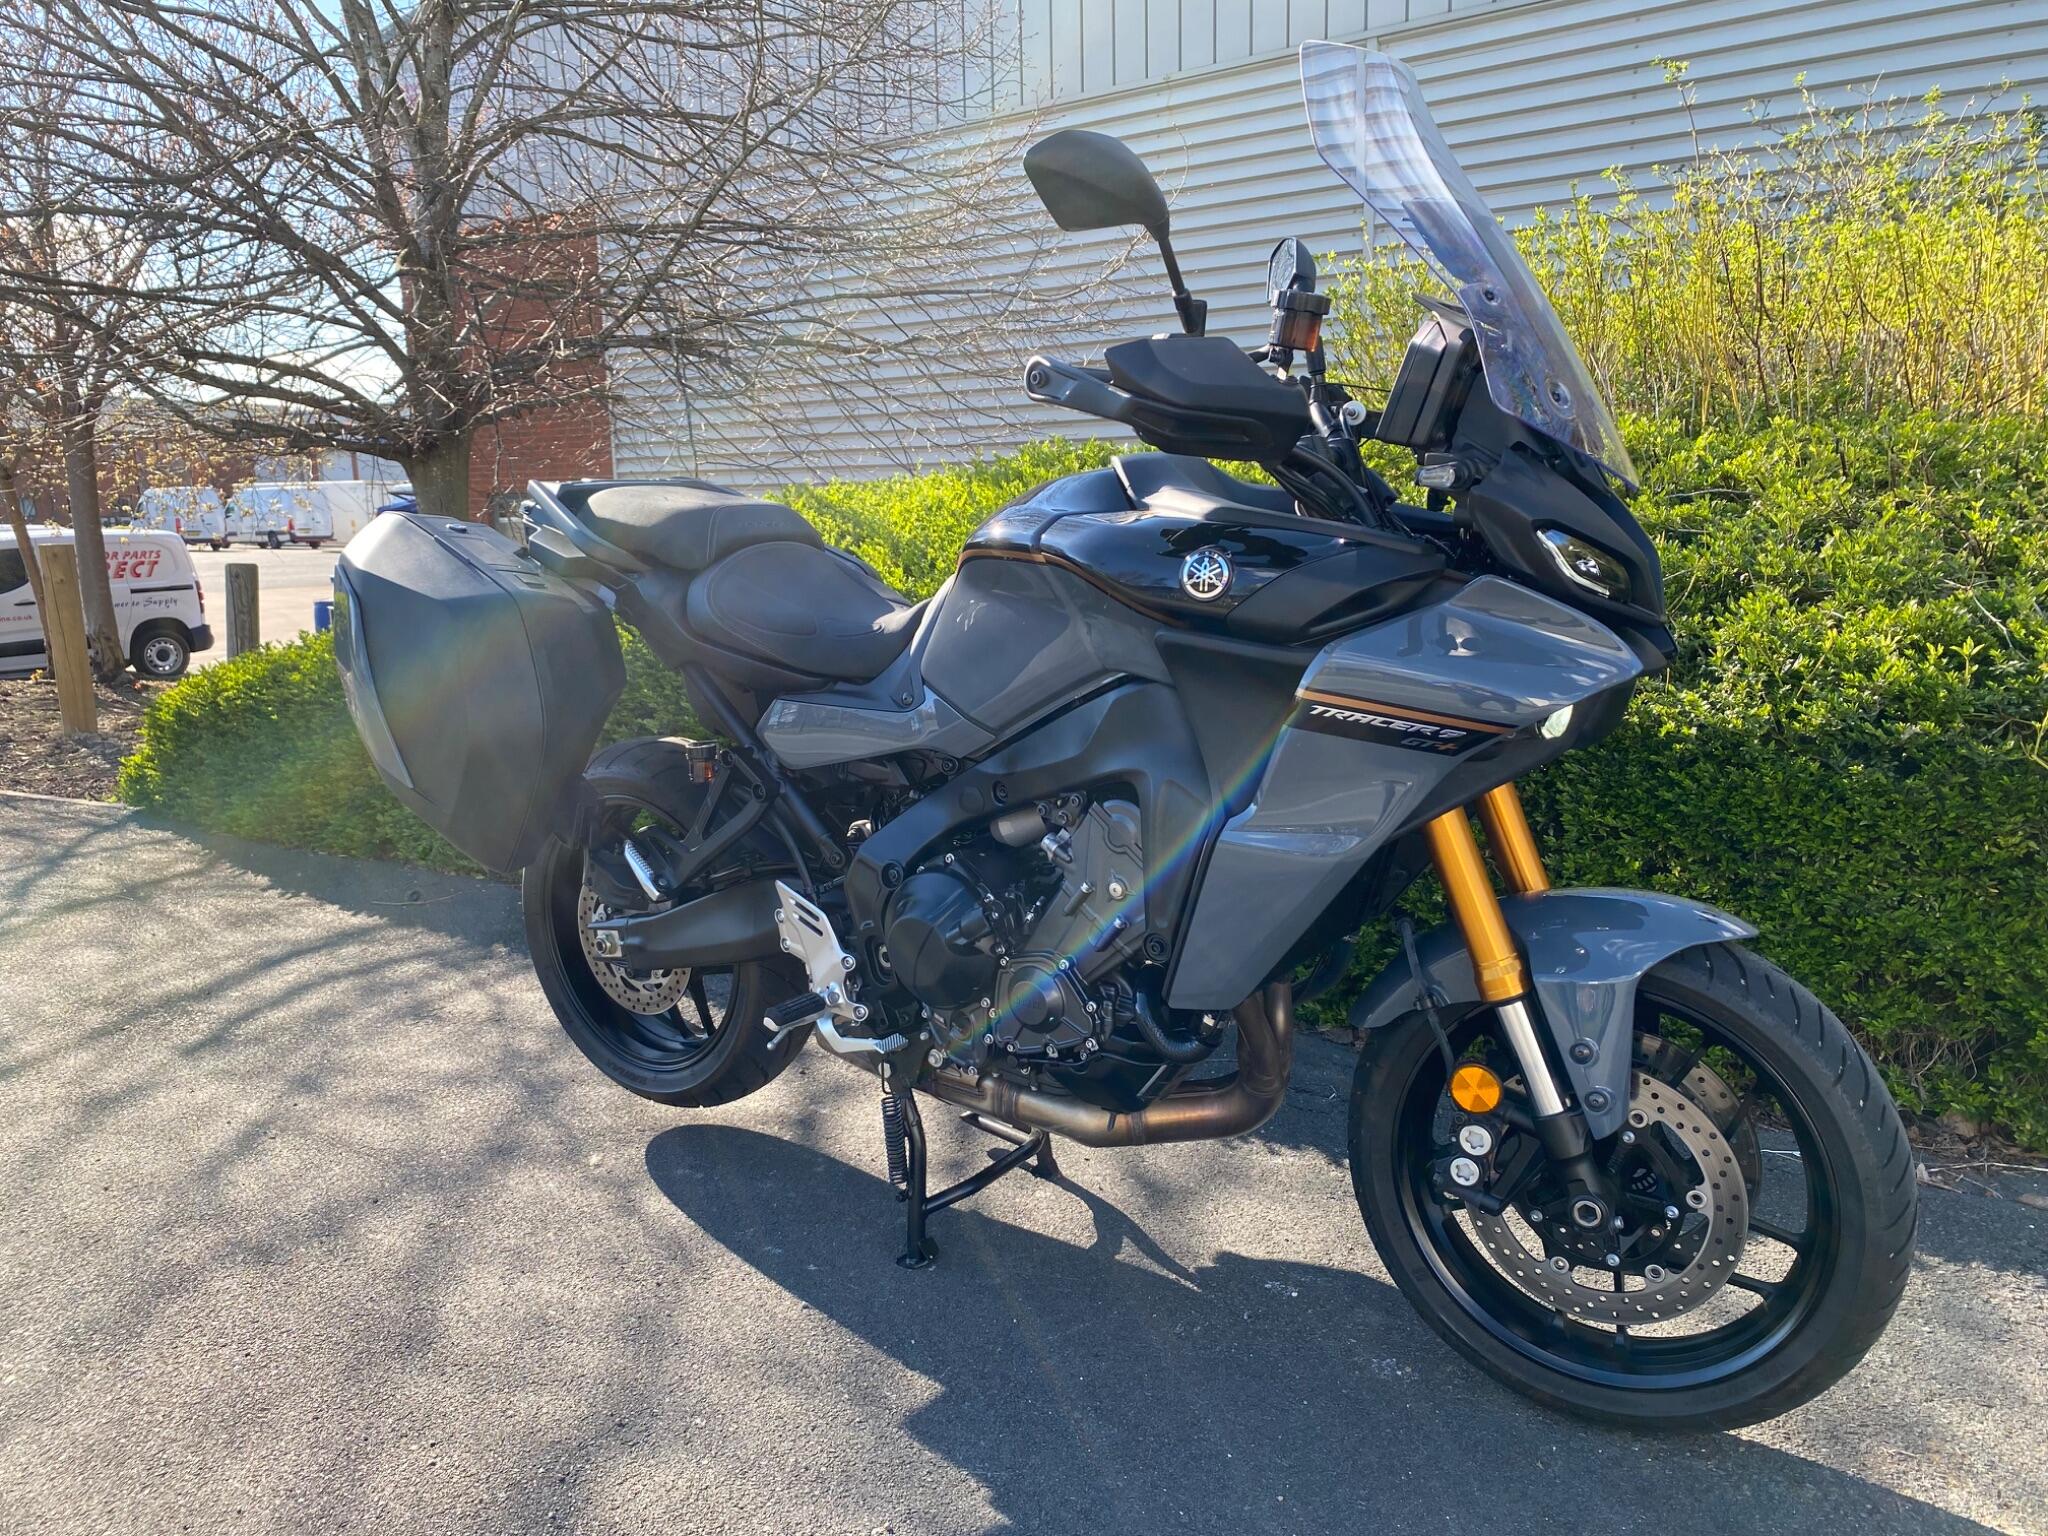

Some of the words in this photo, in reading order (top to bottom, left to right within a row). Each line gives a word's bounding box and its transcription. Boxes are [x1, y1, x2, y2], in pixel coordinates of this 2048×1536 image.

[123, 550, 161, 560] PARTS
[143, 597, 178, 608] Supply
[1309, 705, 1440, 736] TRACER
[1438, 728, 1467, 738] 9
[1401, 737, 1458, 750] GT+
